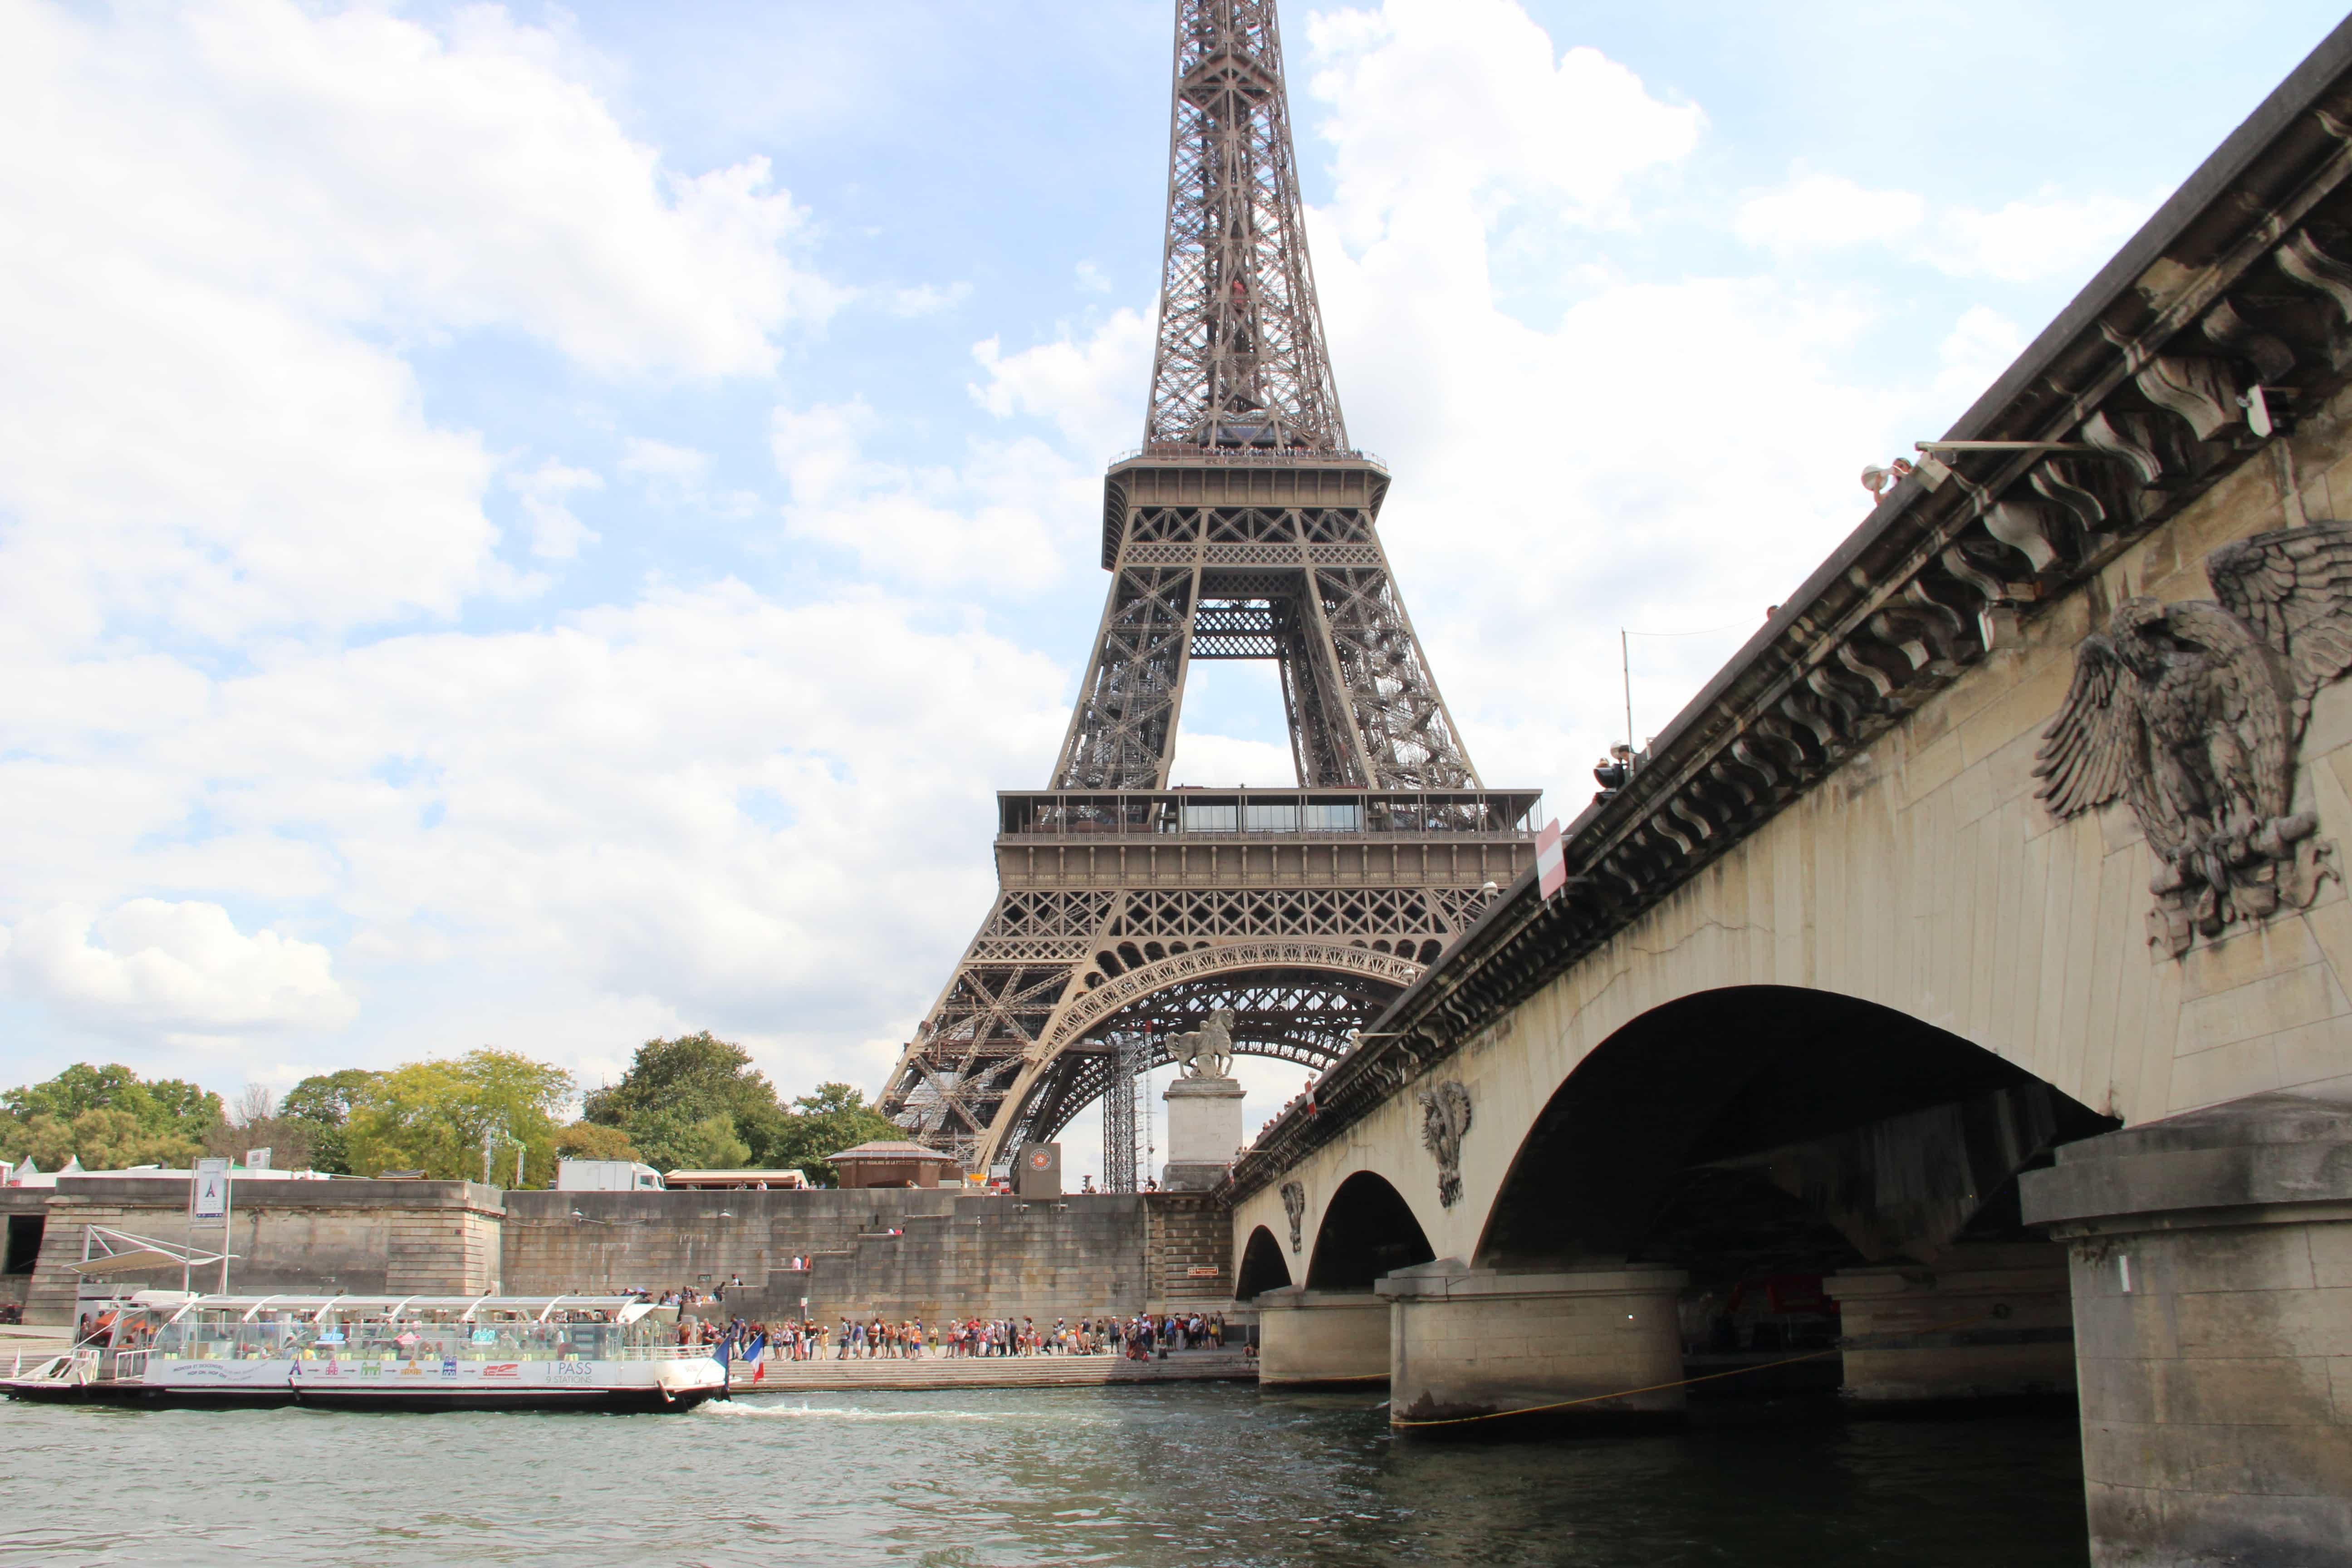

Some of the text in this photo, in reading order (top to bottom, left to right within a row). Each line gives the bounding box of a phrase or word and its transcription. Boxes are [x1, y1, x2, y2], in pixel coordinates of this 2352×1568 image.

[547, 1362, 592, 1374] 1 PASS
[546, 1375, 592, 1383] 9 STATIONS
